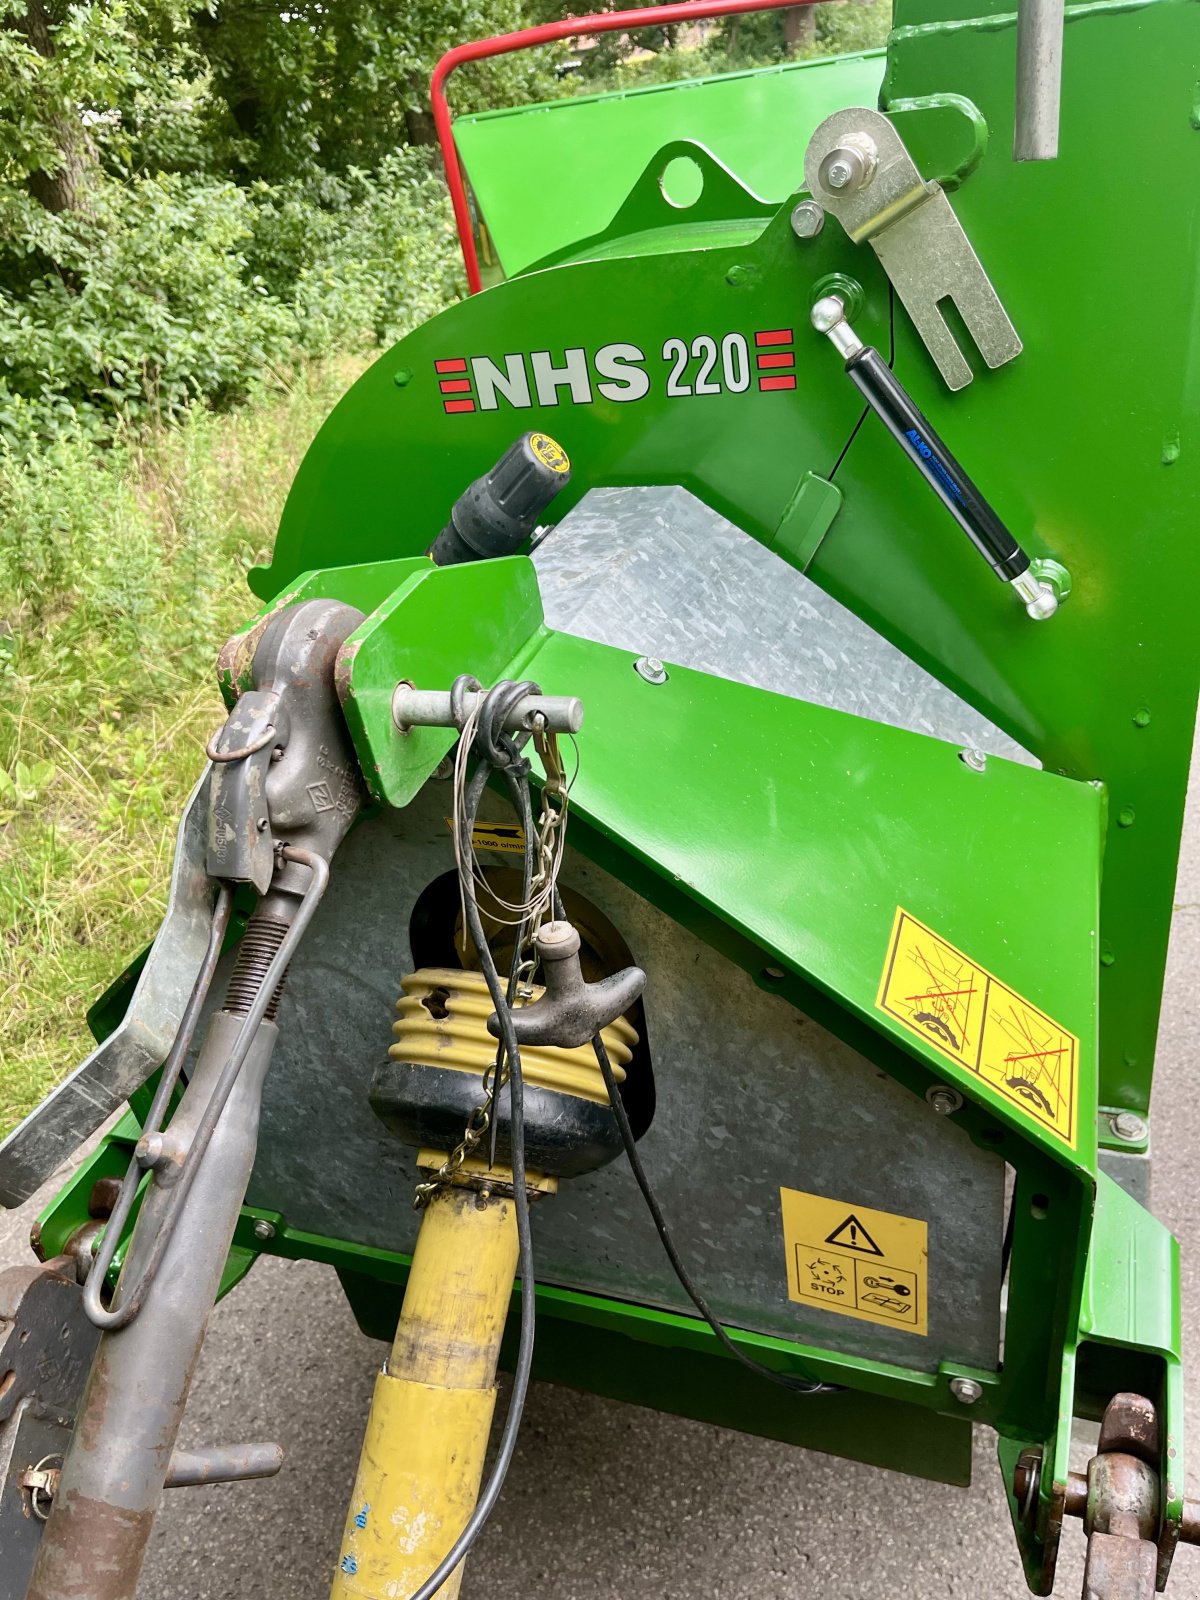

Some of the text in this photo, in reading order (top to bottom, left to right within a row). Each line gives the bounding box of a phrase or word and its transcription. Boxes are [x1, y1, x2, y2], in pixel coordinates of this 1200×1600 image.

[470, 332, 751, 411] NHS 220
[810, 1282, 845, 1296] STOP
